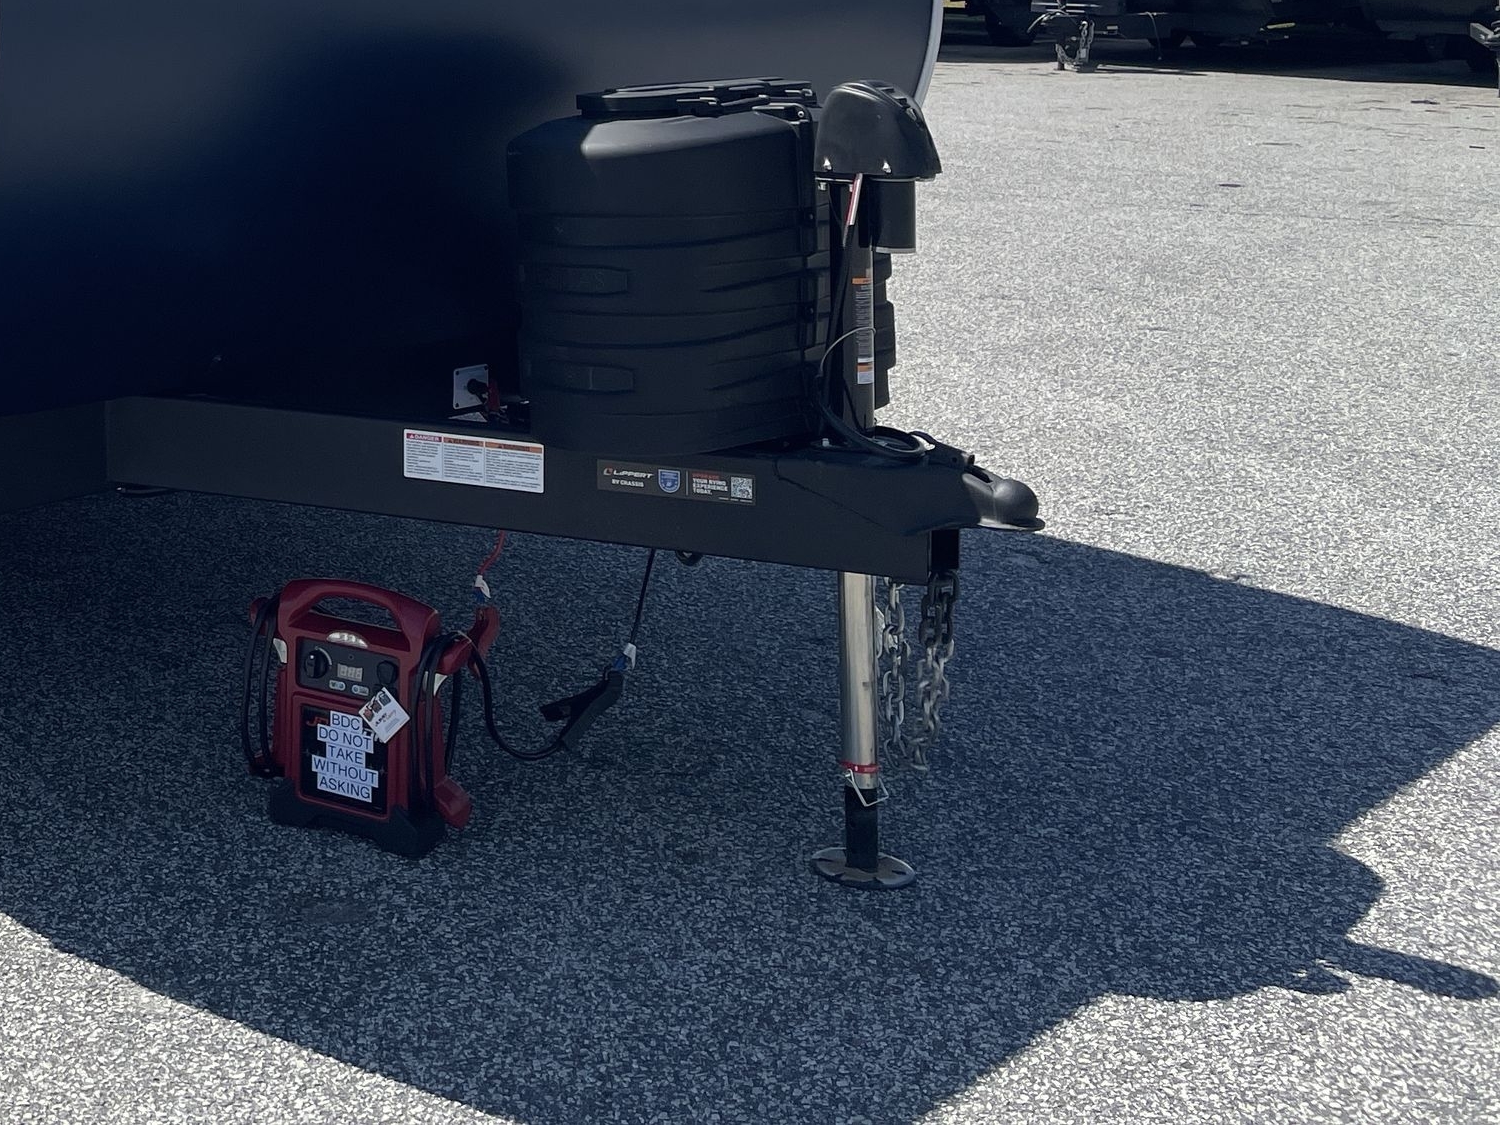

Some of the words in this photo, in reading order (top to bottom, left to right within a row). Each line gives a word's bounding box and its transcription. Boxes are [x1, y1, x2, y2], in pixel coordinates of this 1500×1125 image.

[331, 713, 361, 731] BDC
[319, 726, 339, 742] DO
[342, 732, 372, 750] NOT
[327, 744, 364, 765] TAKE
[313, 757, 378, 784] WITHOUT
[319, 775, 371, 800] ASKING
